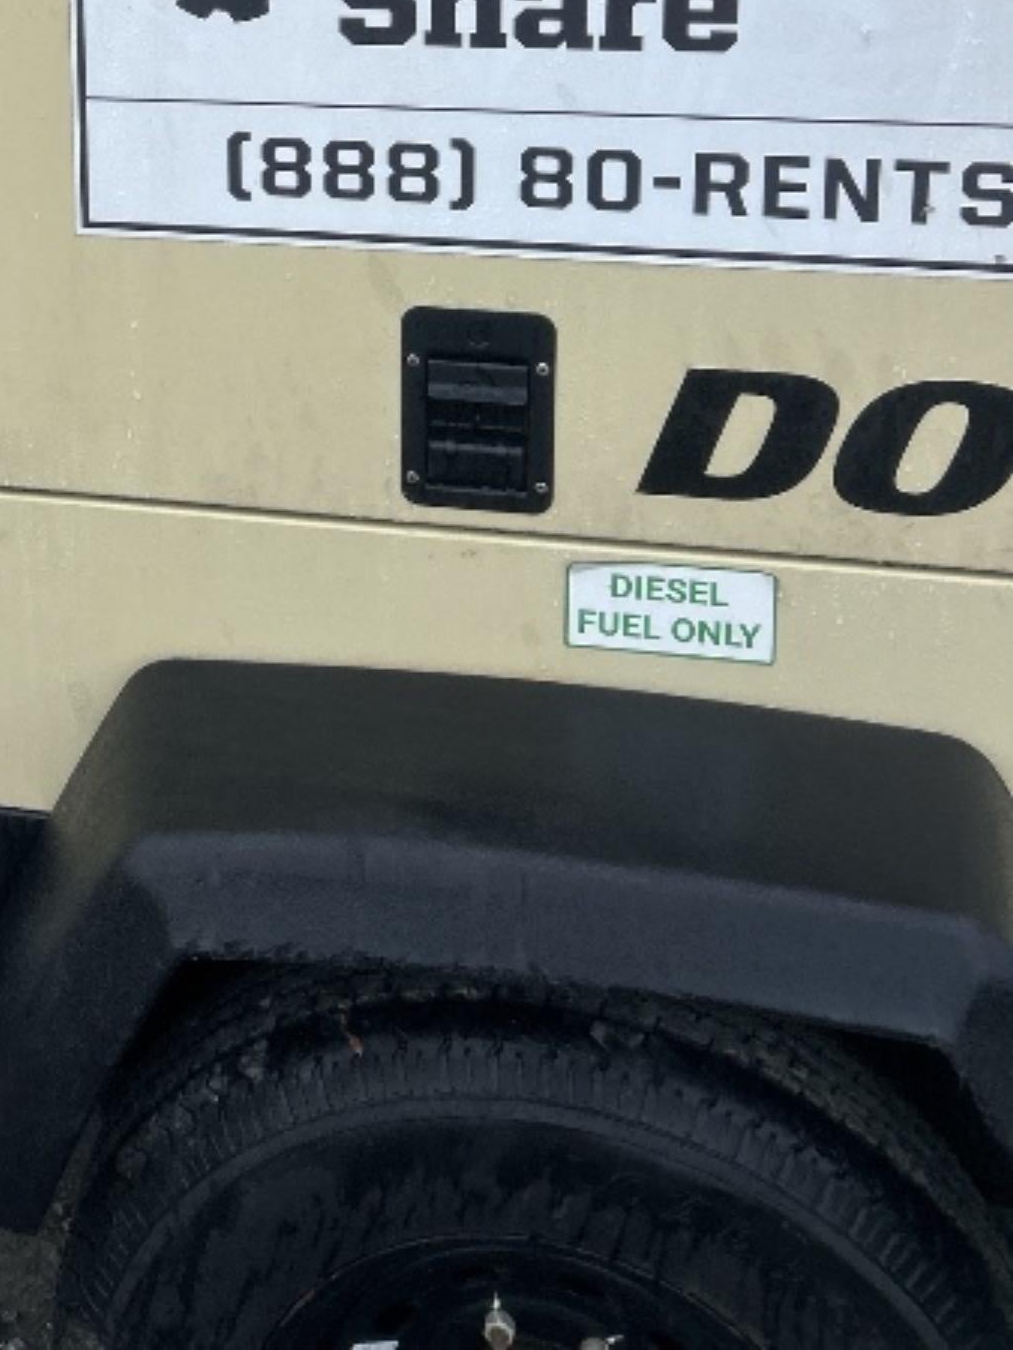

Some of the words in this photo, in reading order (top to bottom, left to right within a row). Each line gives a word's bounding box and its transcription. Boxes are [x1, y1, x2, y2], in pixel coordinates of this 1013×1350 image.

[227, 131, 476, 211] (888)
[520, 146, 1013, 229] 80-RENTS
[609, 572, 729, 607] DIESEL
[577, 608, 661, 641] FUEL
[670, 617, 761, 649] ONLY
